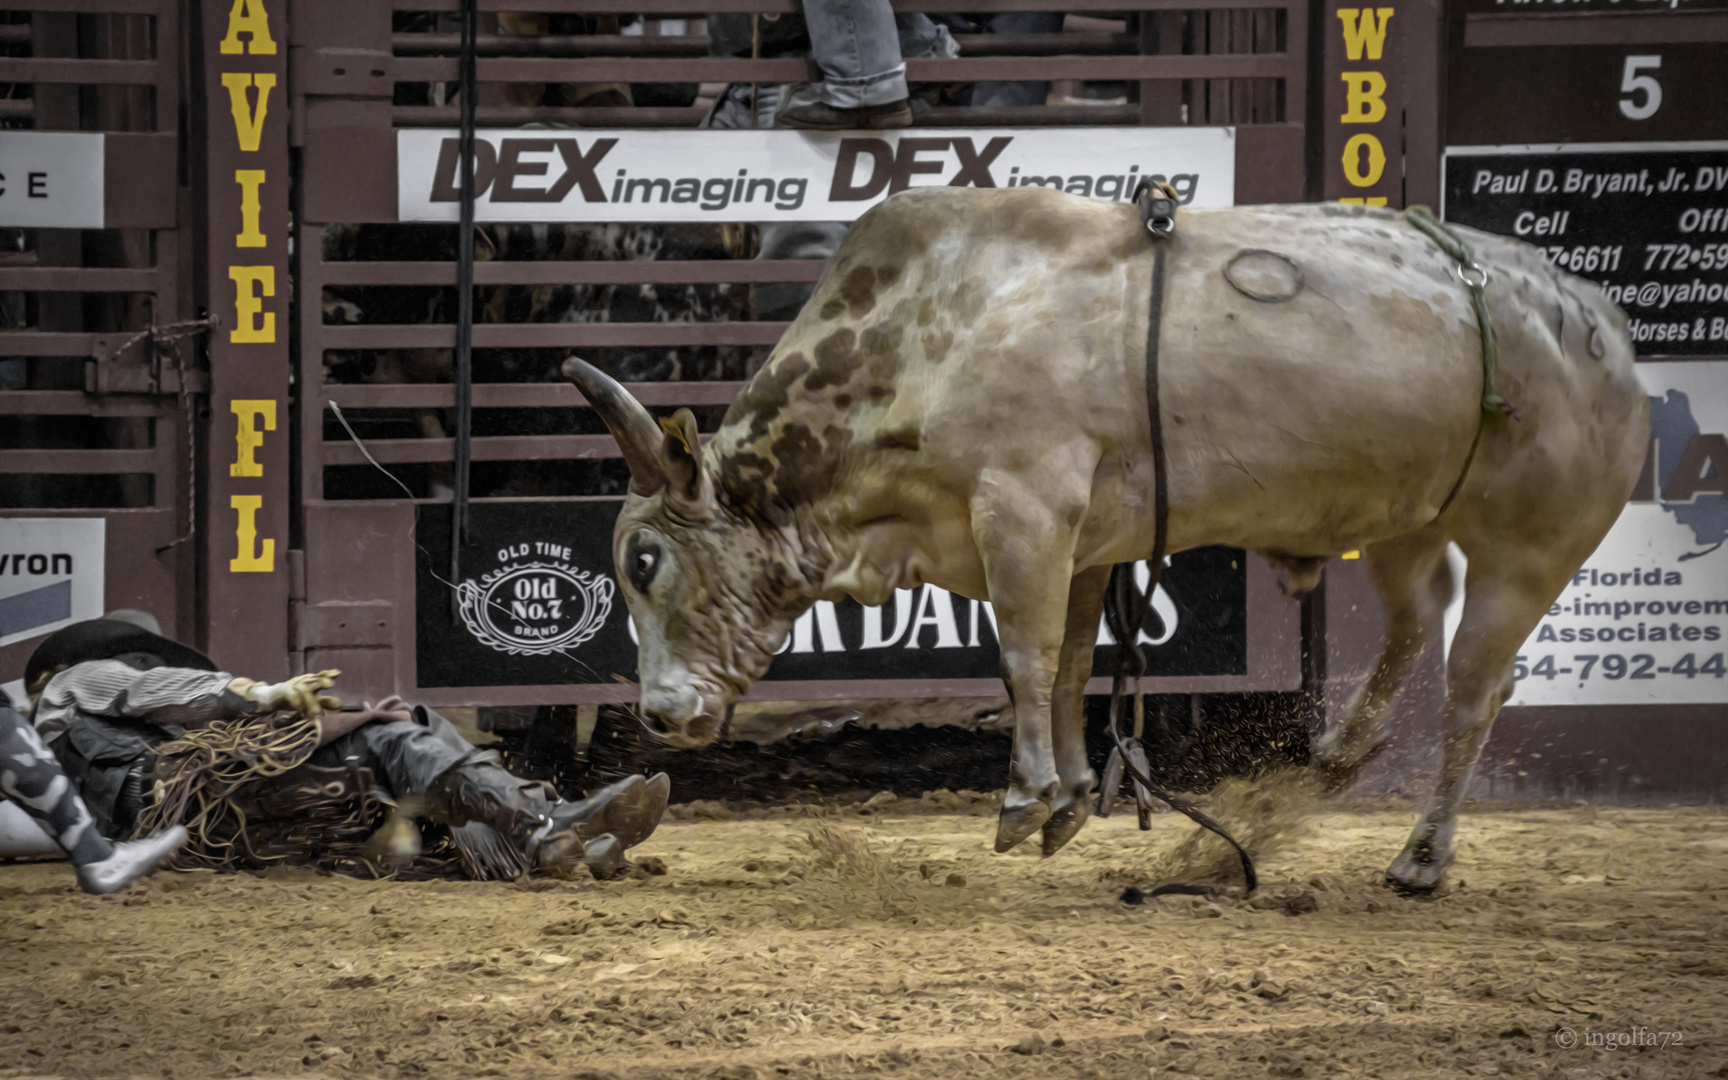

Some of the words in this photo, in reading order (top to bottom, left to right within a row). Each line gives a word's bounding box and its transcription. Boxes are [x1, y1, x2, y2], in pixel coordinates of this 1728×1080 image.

[1619, 54, 1663, 120] 5
[1337, 7, 1394, 208] WBO
[429, 137, 620, 203] DEX
[610, 168, 808, 211] imaging
[828, 136, 1014, 202] DEX
[1472, 169, 1529, 194] Paul
[1534, 168, 1558, 193] D.
[1563, 167, 1653, 199] Bryant,
[1658, 166, 1690, 192] Jr.
[1514, 211, 1570, 236] Cell
[1691, 317, 1707, 341] &
[497, 543, 530, 562] OLD
[534, 541, 572, 561] TIME
[514, 577, 558, 600] Old
[1572, 567, 1683, 587] Florida
[513, 624, 559, 637] BRAND
[1536, 622, 1722, 643] Associates
